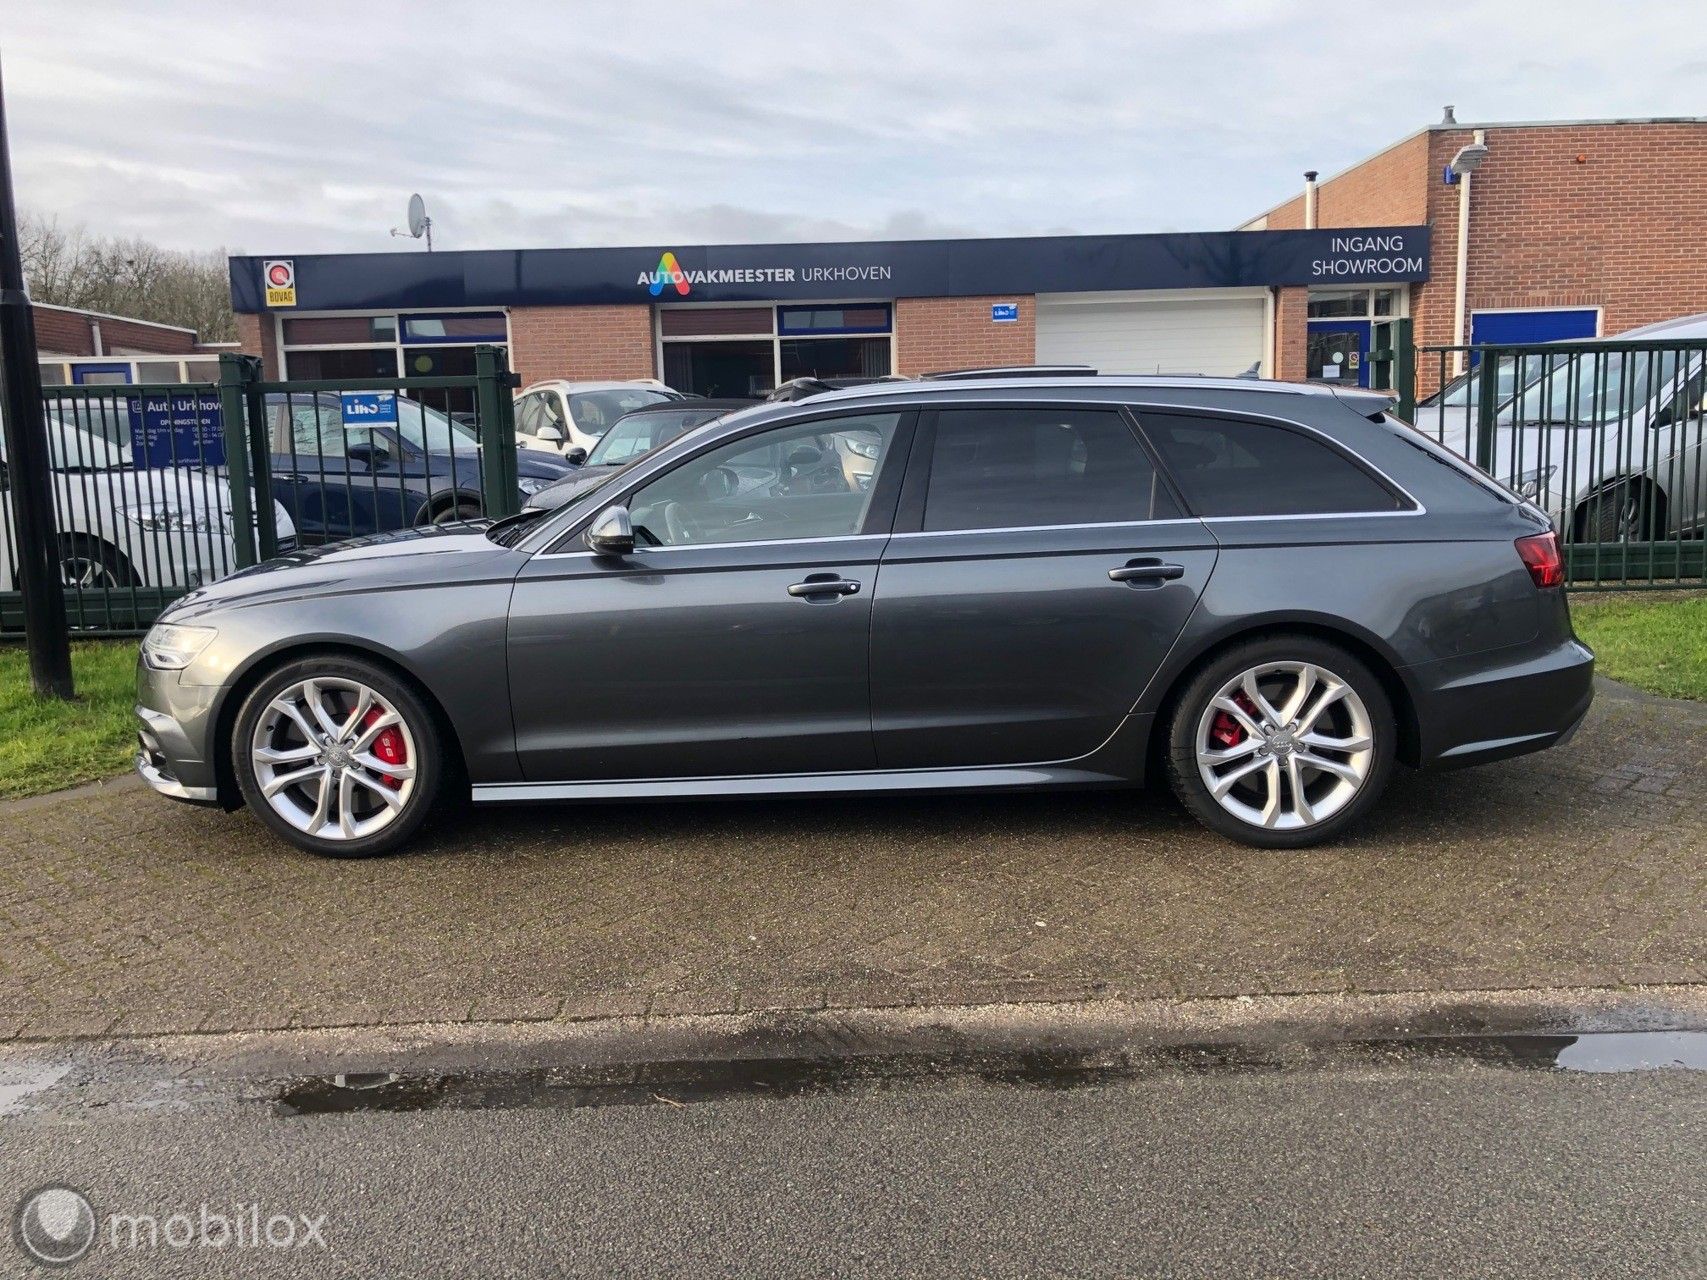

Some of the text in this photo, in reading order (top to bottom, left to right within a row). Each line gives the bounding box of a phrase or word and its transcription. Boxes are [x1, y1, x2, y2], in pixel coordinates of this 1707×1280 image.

[1331, 235, 1404, 253] INGANG
[636, 265, 892, 286] AUTOVAKMEESTER URKHOVEN
[1311, 257, 1423, 276] SHOWROOM
